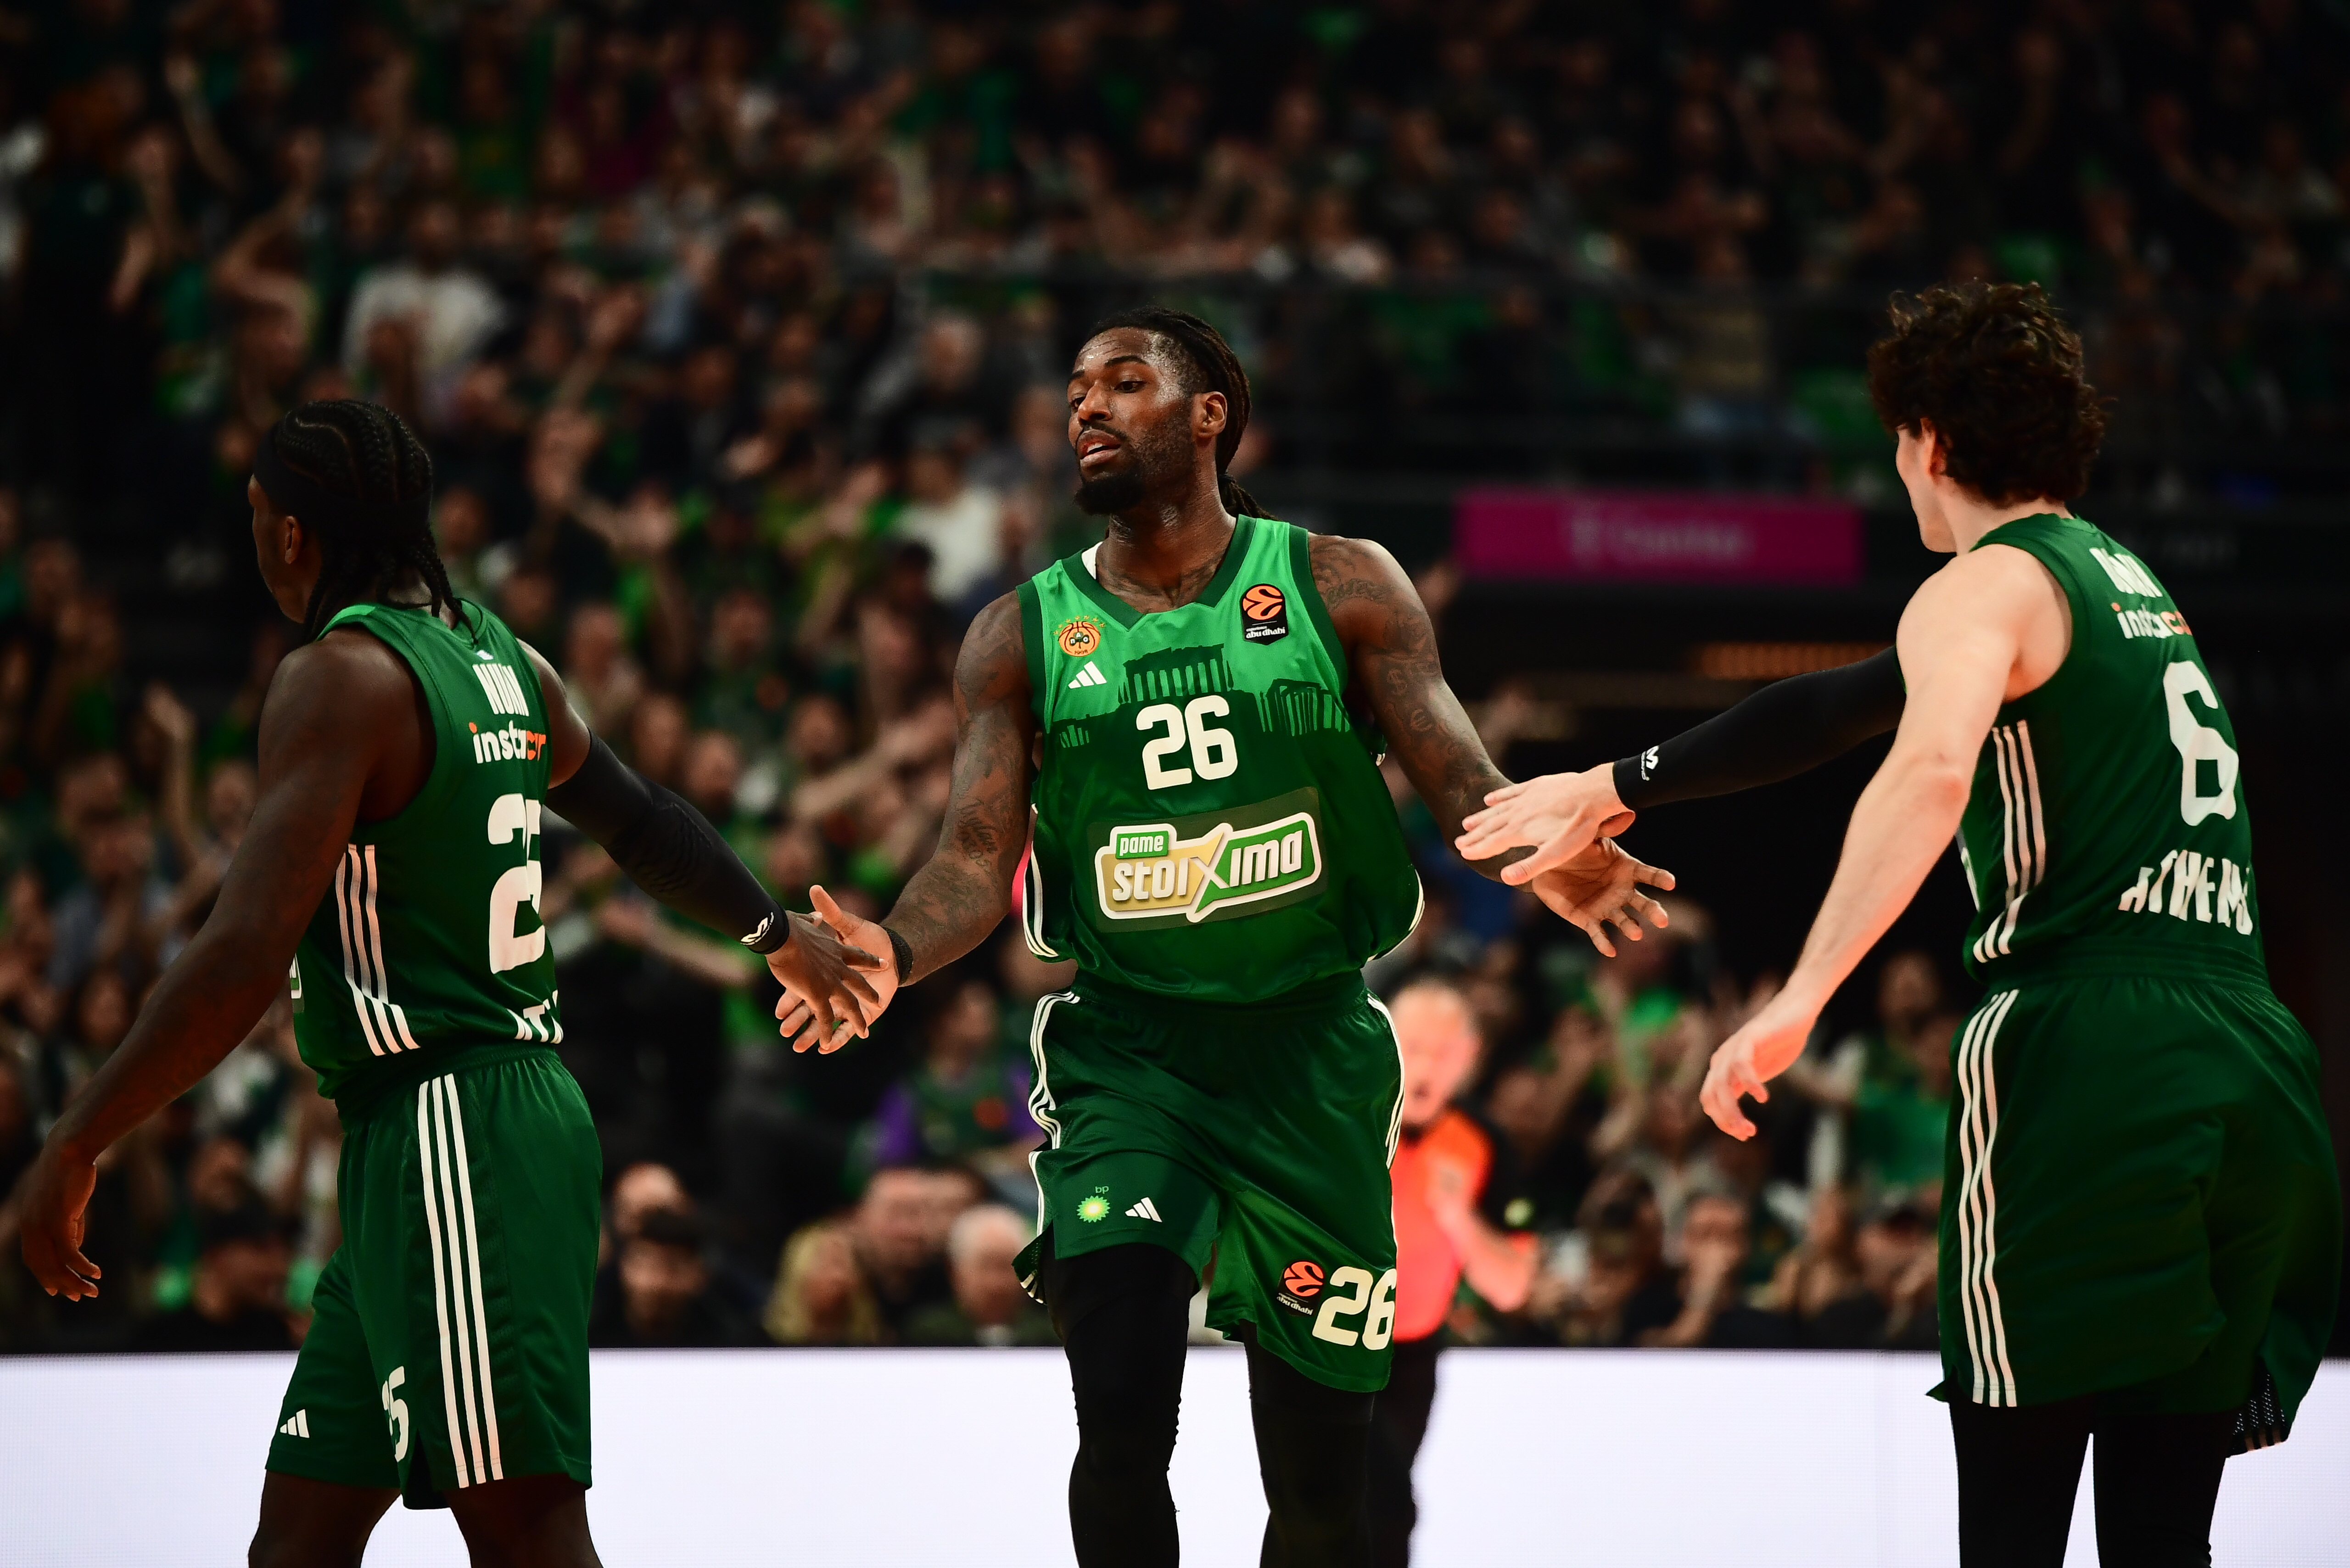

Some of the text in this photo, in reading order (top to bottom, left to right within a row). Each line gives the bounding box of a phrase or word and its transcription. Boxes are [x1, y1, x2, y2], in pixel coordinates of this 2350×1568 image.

[1262, 627, 1286, 636] dhabi
[1136, 695, 1238, 790] 26
[2163, 661, 2239, 826] 6
[1119, 835, 1164, 856] pame
[1095, 1186, 1109, 1194] bp
[1276, 1296, 1314, 1316] abu dhabi
[1312, 1266, 1397, 1350] 26
